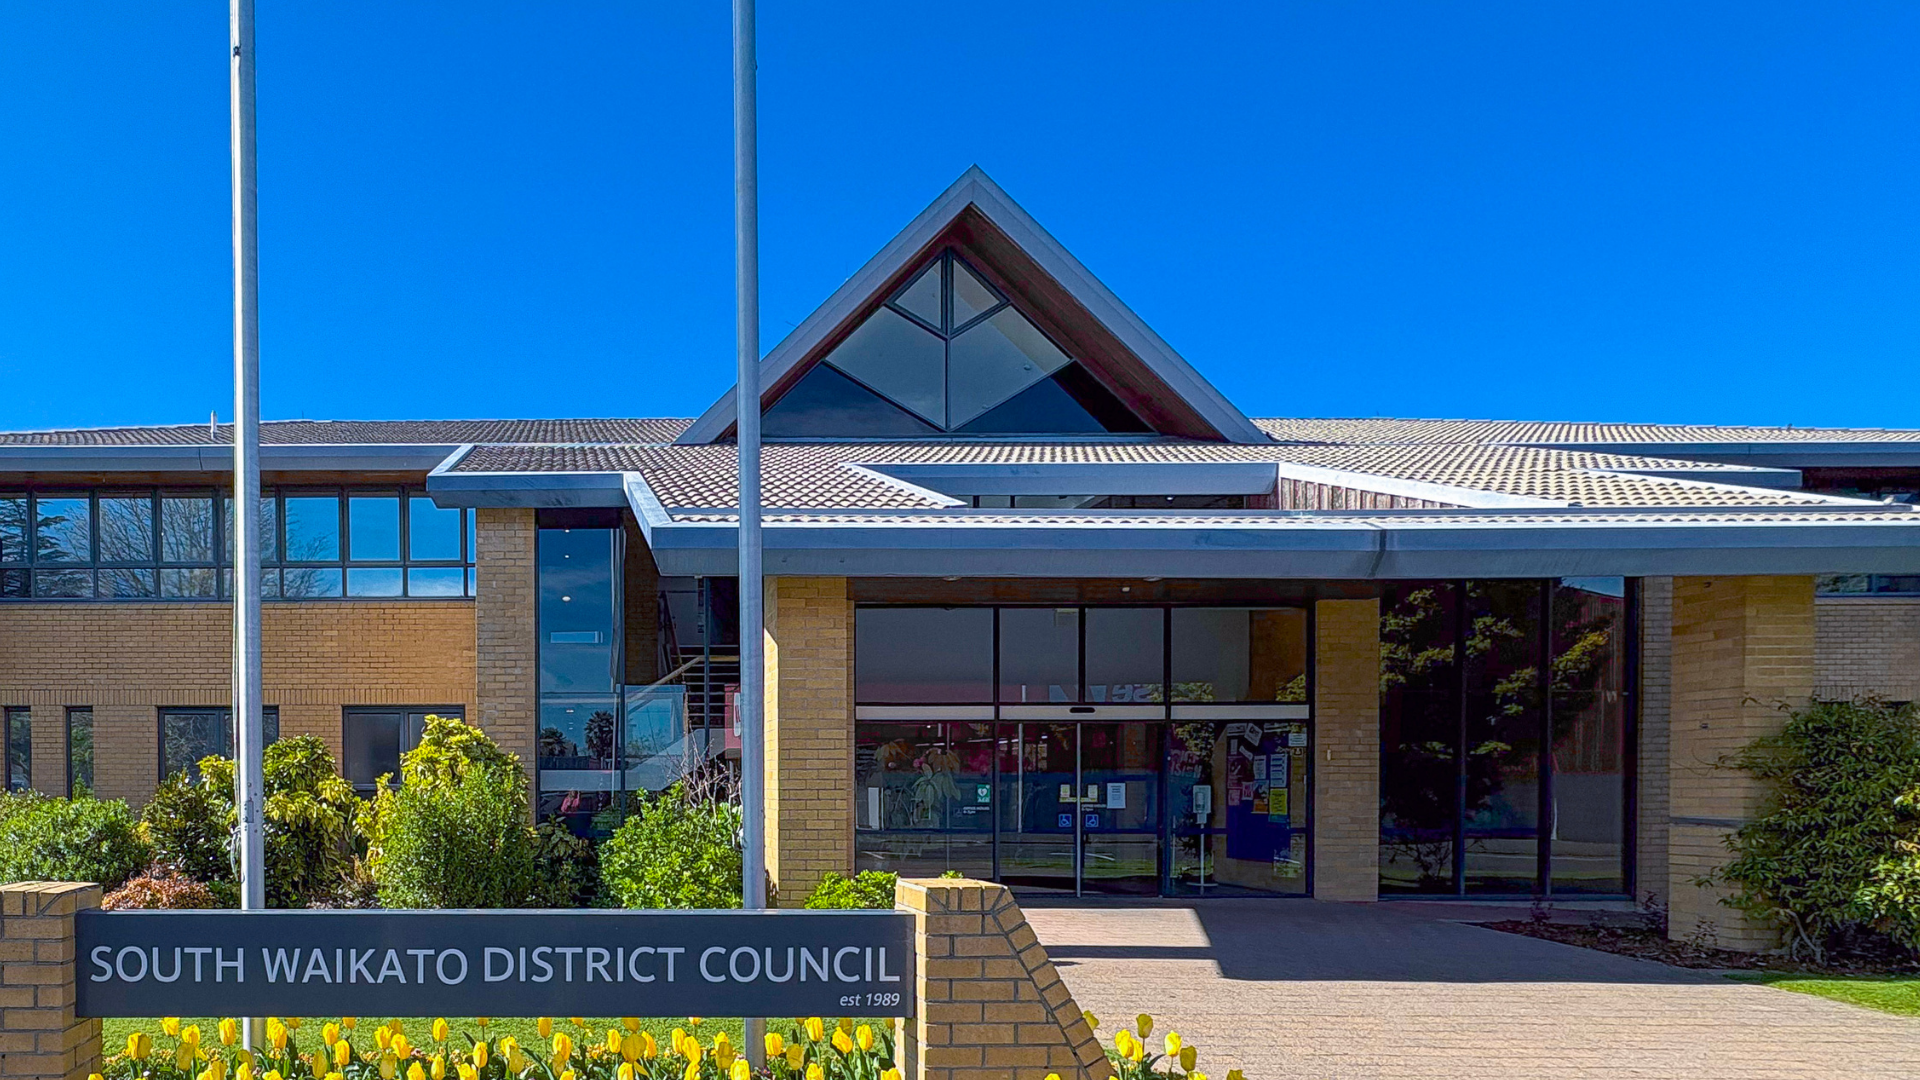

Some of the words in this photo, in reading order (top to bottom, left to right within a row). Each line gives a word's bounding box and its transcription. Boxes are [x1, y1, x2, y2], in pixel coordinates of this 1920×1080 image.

[90, 946, 245, 983] SOUTH
[261, 947, 468, 985] WAIKATO
[484, 946, 685, 983] DISTRICT
[699, 946, 901, 983] COUNCIL
[839, 993, 862, 1007] est
[865, 992, 900, 1007] 1989
